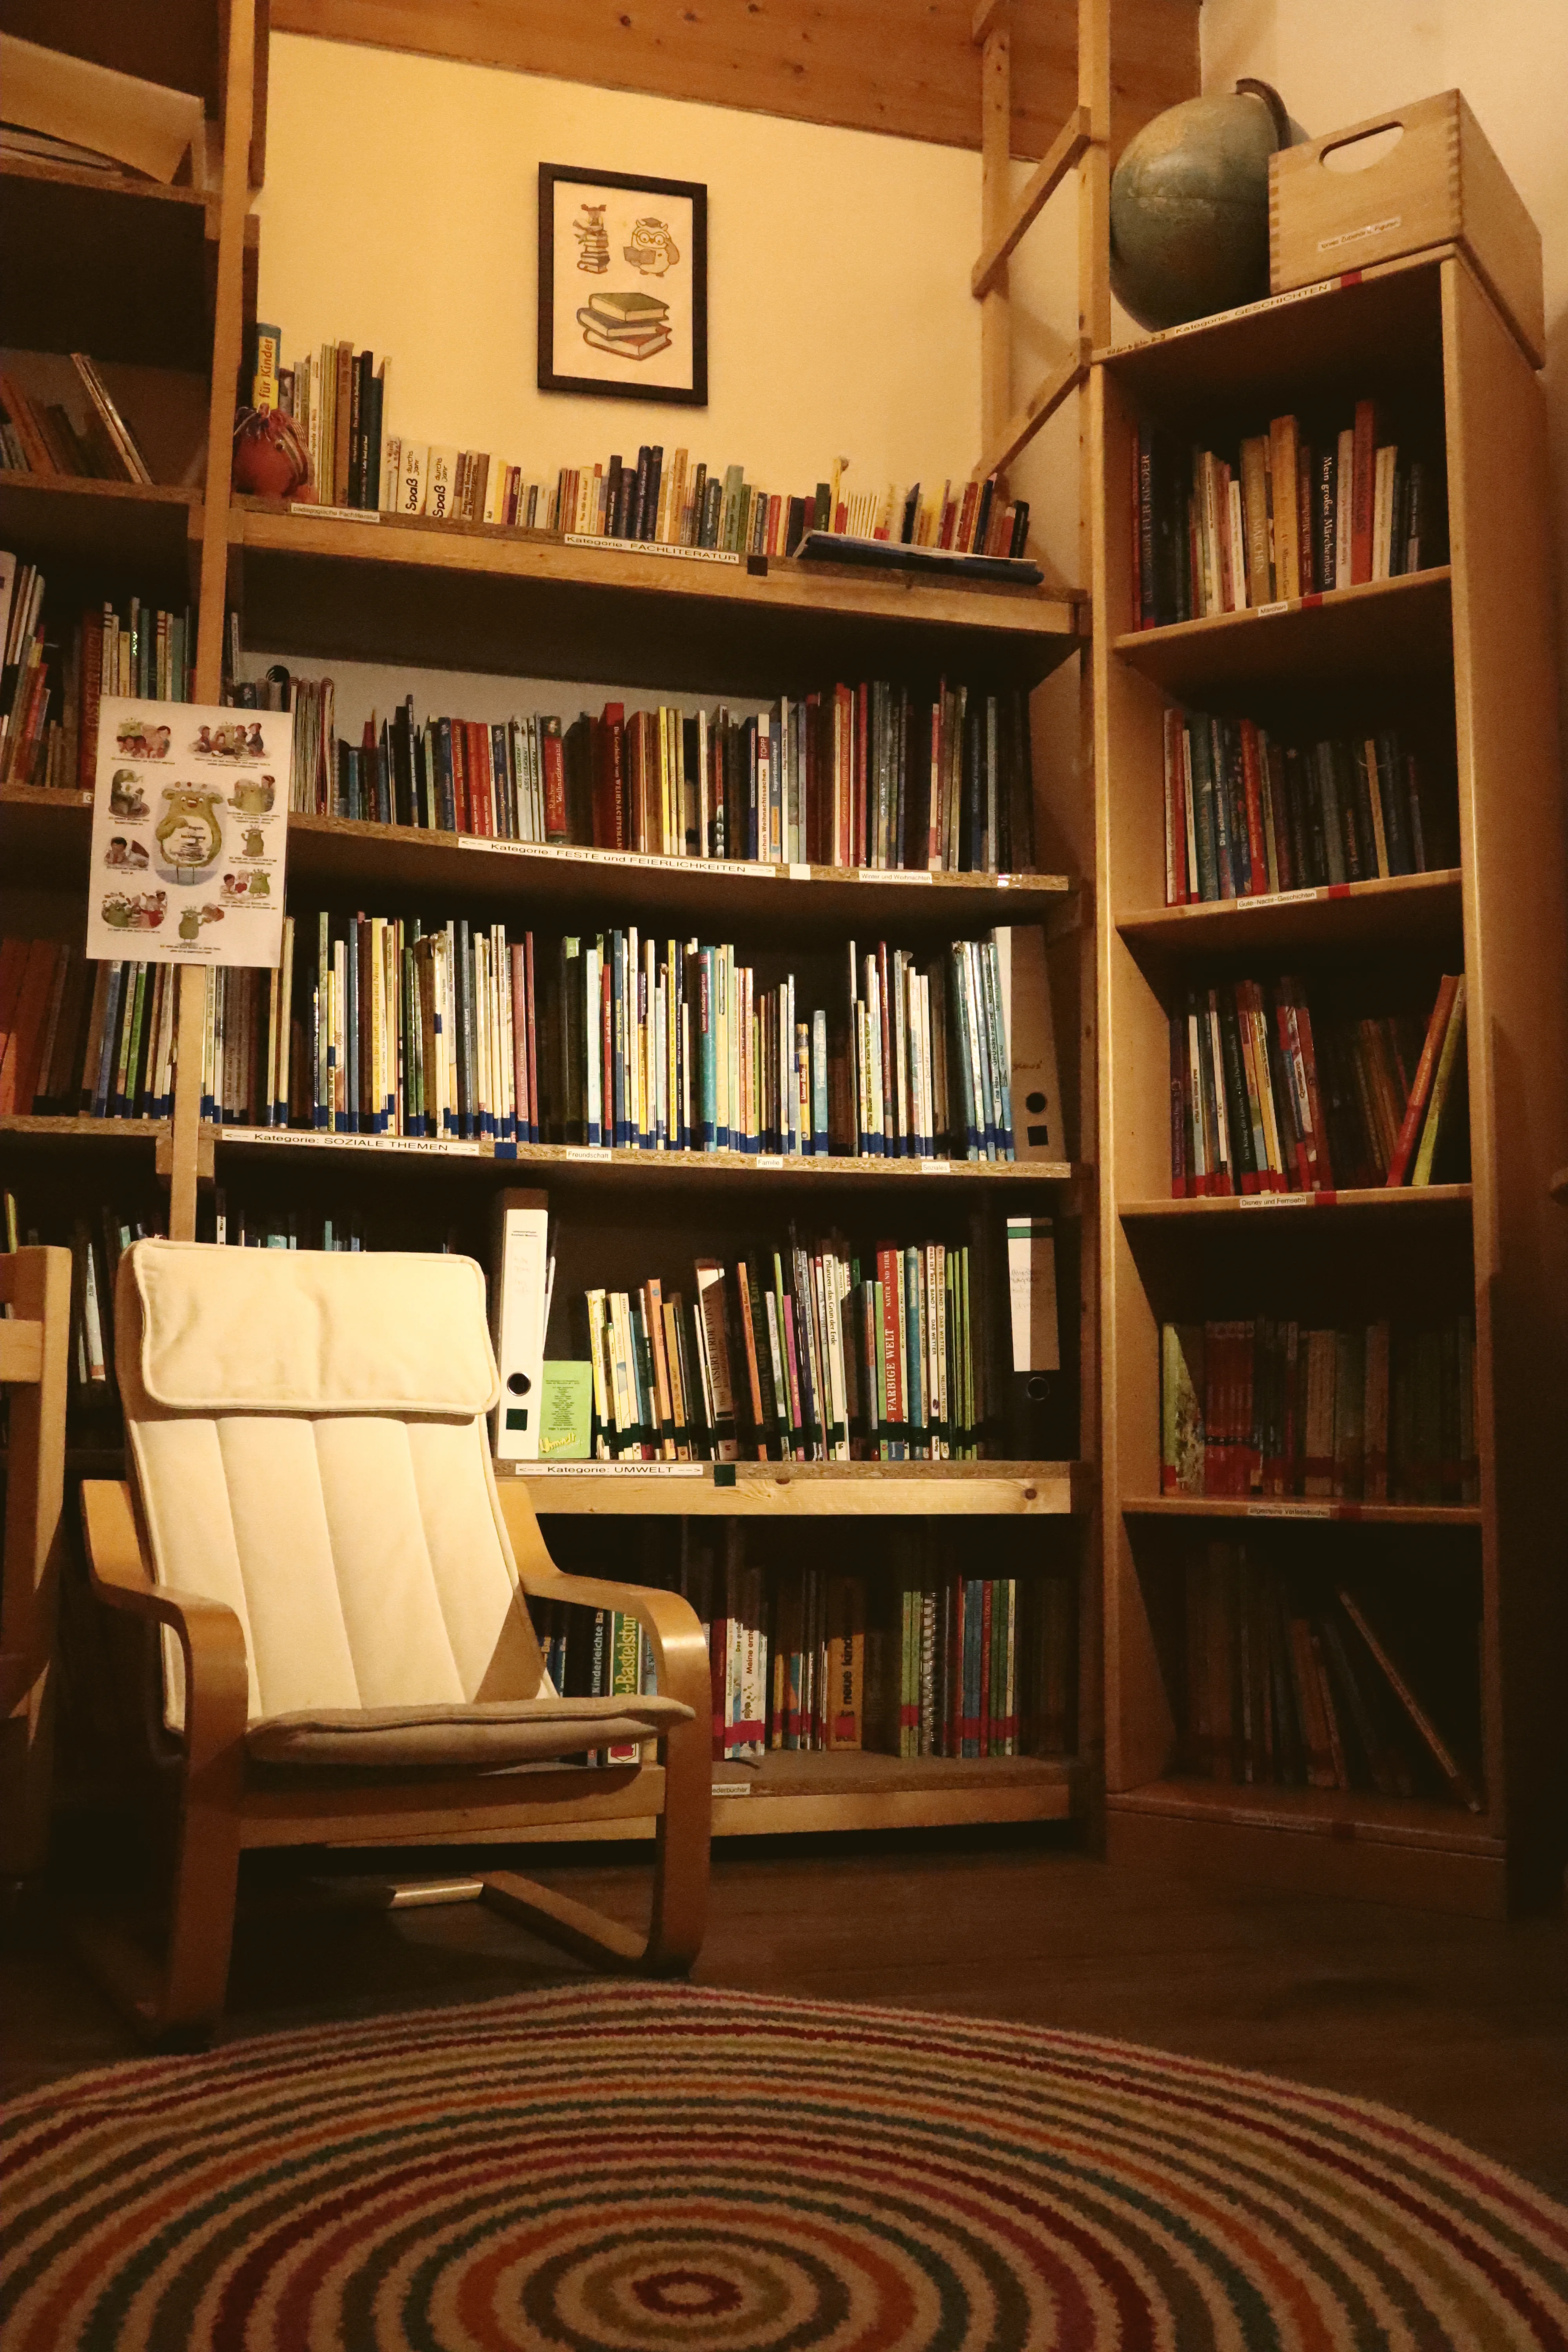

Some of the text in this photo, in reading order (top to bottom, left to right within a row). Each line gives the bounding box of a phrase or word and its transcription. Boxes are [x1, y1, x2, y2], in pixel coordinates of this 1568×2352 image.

[1234, 284, 1328, 316] GESCHICHTEN
[258, 338, 273, 398] für Kinder
[432, 457, 446, 518] Spaß durchs
[1142, 455, 1151, 501] KINDER
[405, 479, 418, 511] Spaß
[1321, 457, 1334, 584] Mein großes Märchenbuch
[630, 543, 737, 562] FACHLITERATUR
[491, 843, 746, 872] Kategorie: FESTE und FEIERLICHKEITEN
[254, 1134, 448, 1151] Kategorie: SOZIALE THEMEN
[704, 1307, 714, 1326] VON
[707, 1328, 717, 1351] ERDE
[885, 1329, 895, 1359] WELT
[709, 1354, 721, 1388] UNSERE
[887, 1363, 897, 1411] FARBIGE
[539, 1432, 576, 1454] Umwelt
[592, 1625, 603, 1693] Kinderleichte
[842, 1671, 853, 1705] neue
